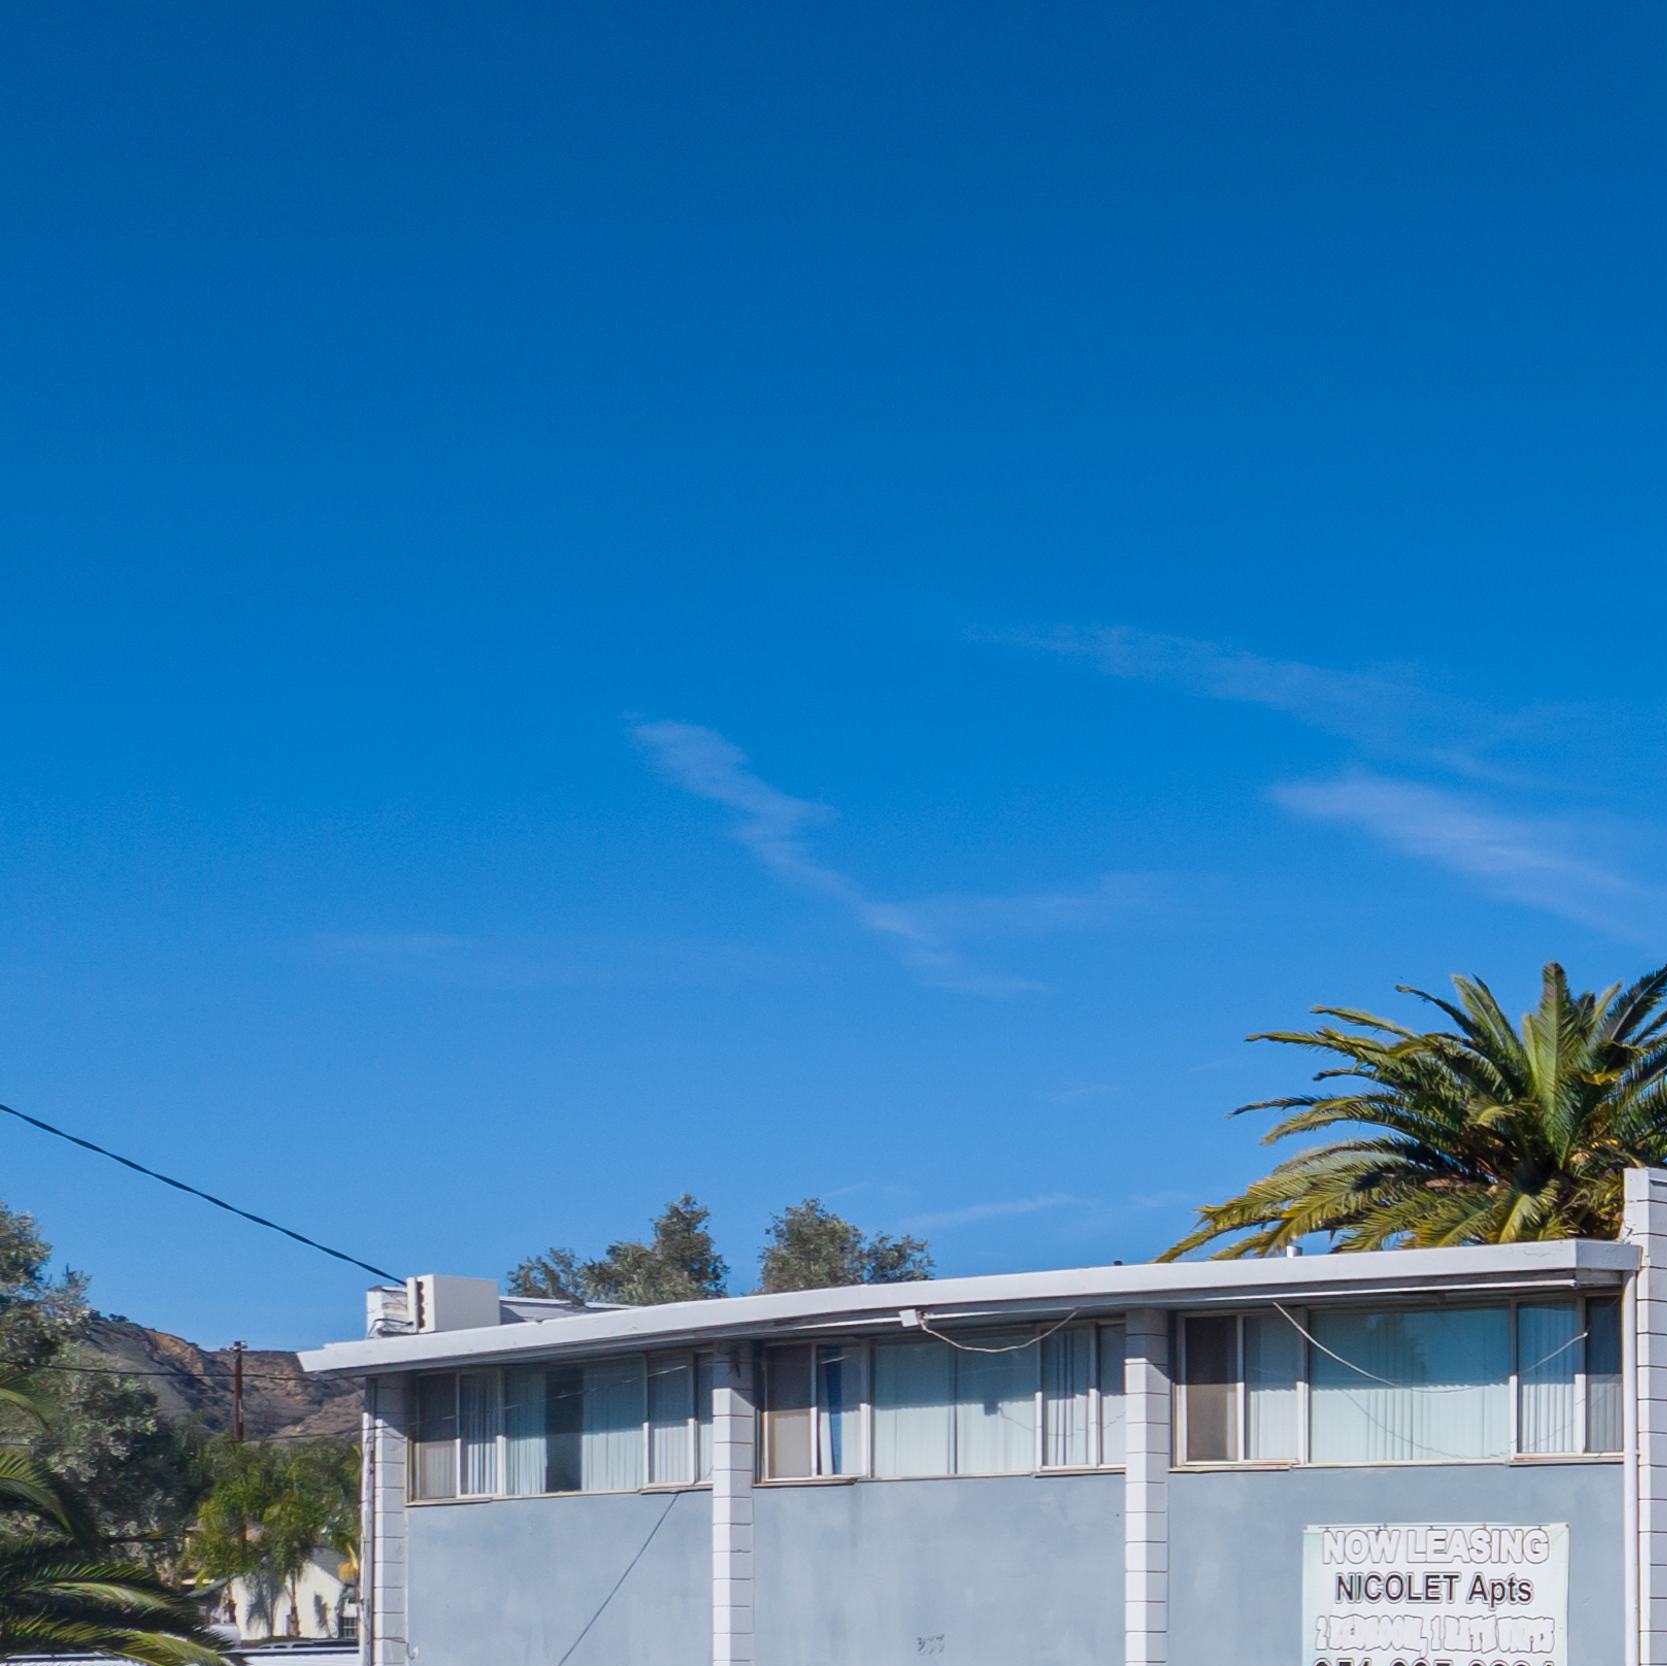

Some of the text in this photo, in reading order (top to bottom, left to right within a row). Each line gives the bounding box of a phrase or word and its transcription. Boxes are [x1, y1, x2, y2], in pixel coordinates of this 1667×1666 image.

[1323, 1529, 1549, 1565] NOW LEASING
[1336, 1573, 1533, 1610] NICOLET Apts
